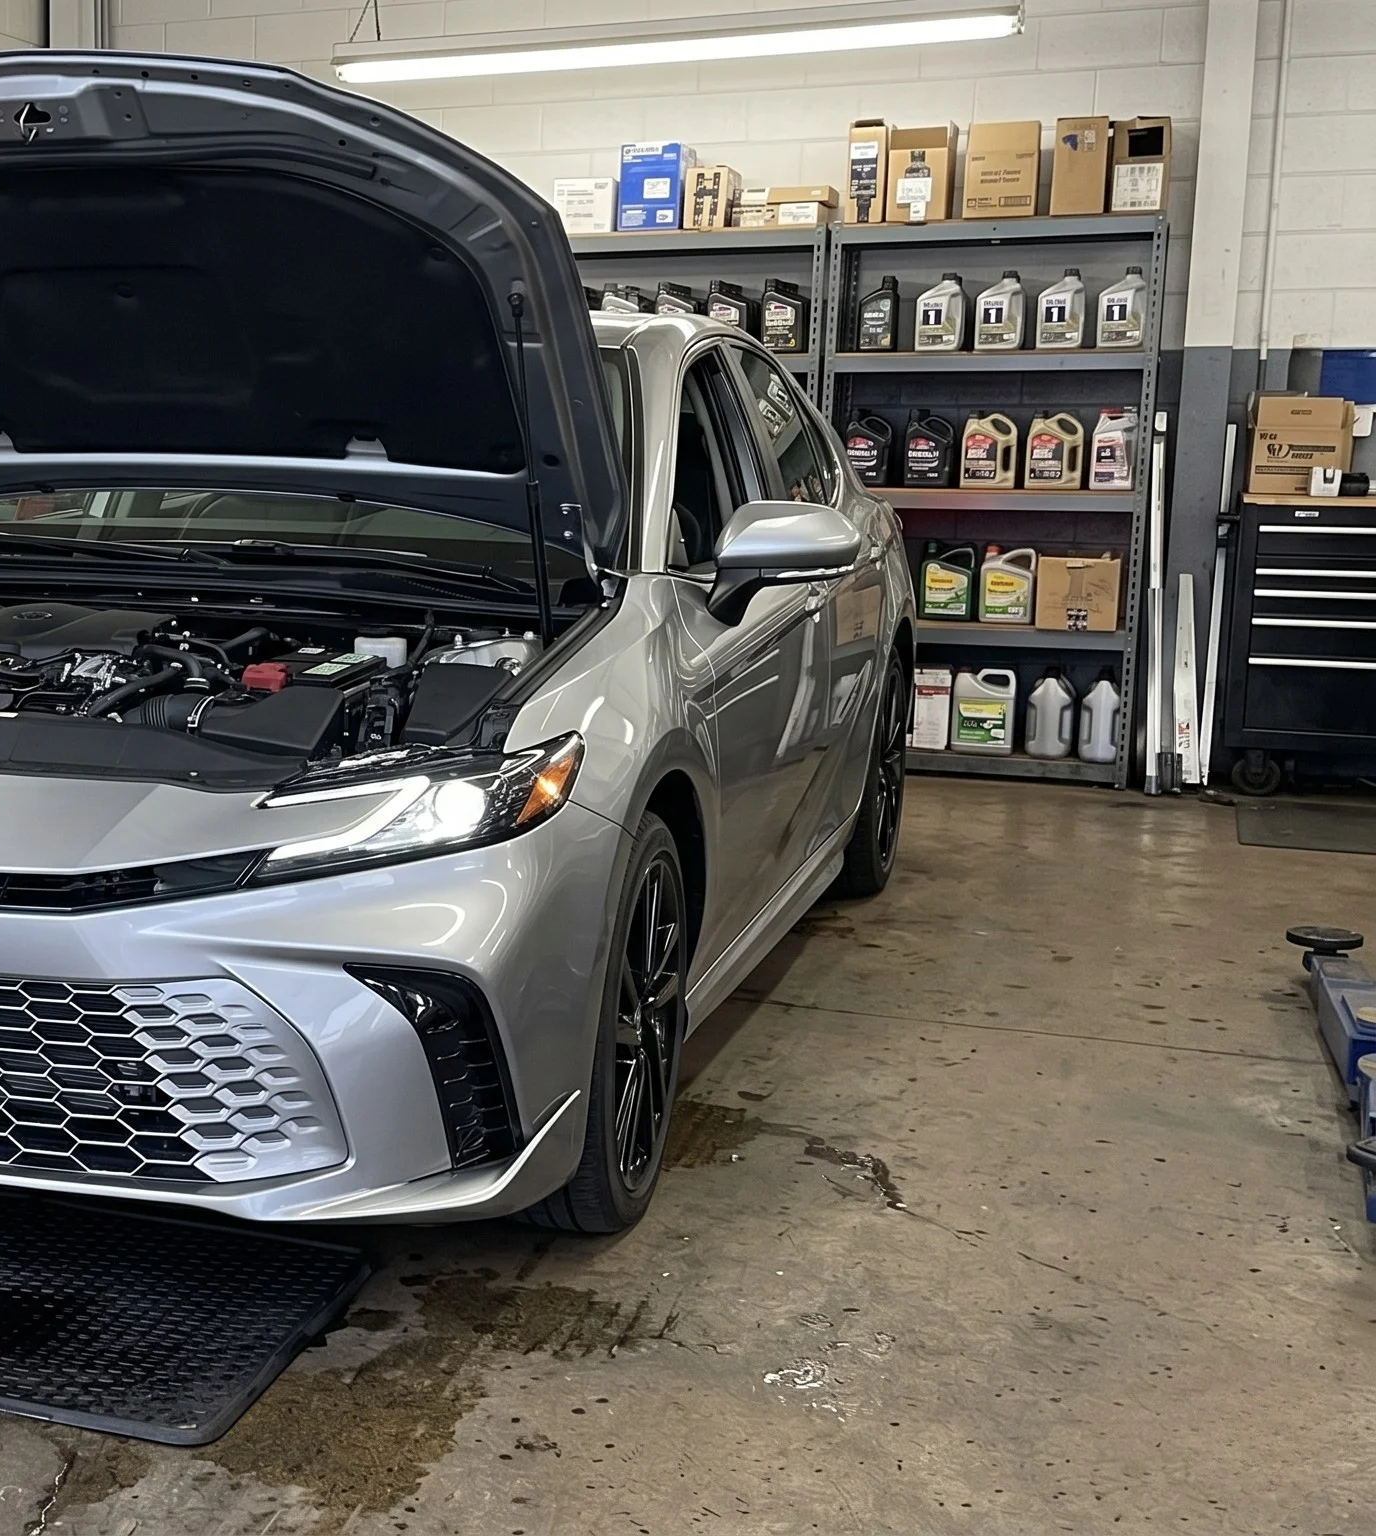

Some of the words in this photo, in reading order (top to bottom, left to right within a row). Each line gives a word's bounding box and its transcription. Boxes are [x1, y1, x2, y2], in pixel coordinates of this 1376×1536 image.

[928, 310, 936, 325] 1
[988, 308, 996, 323] 1
[1051, 307, 1059, 322] 1
[1112, 305, 1120, 320] 1
